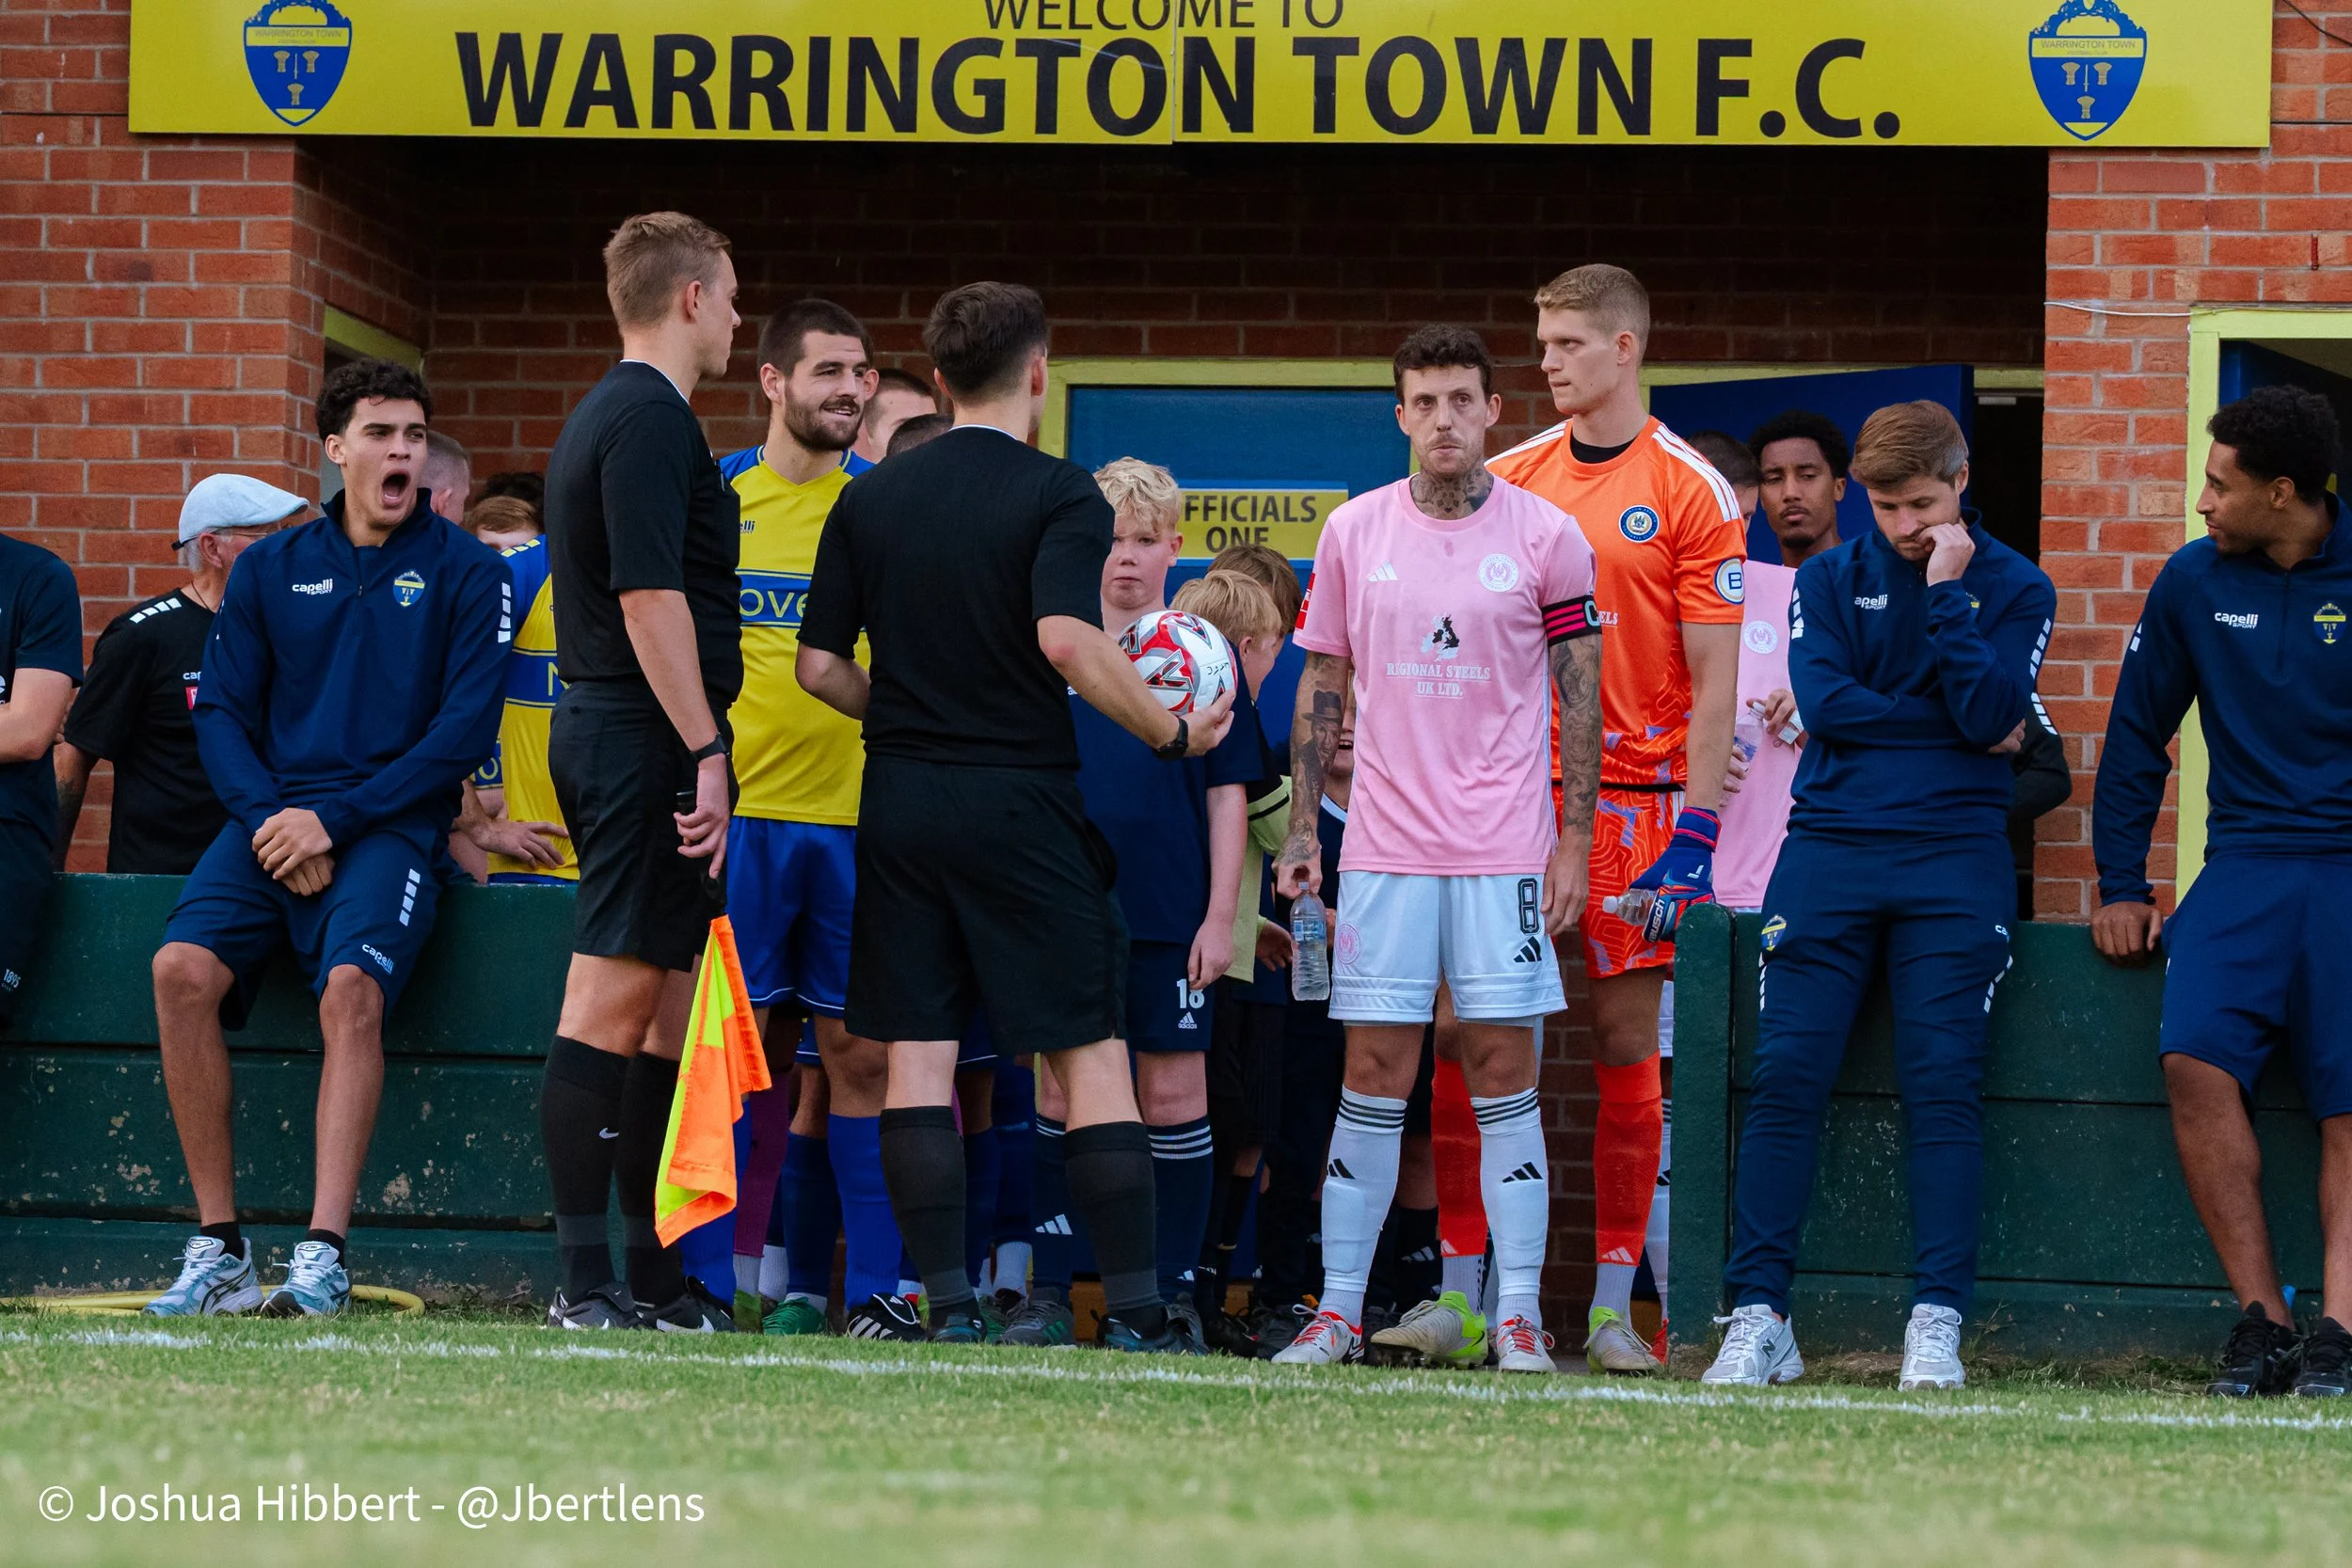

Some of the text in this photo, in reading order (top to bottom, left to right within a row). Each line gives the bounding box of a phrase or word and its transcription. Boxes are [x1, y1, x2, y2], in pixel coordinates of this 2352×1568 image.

[984, 0, 1255, 30] WELCOME
[454, 31, 1901, 139] WARRINGTON TOWN F.C.
[1184, 495, 1317, 523] FFICIALS
[292, 578, 333, 594] capelli
[1727, 571, 1743, 590] B
[1854, 594, 1888, 608] apelli
[2214, 612, 2259, 626] capelli
[1446, 665, 1491, 679] STEELS
[1416, 681, 1435, 695] UK
[1518, 878, 1540, 934] 8
